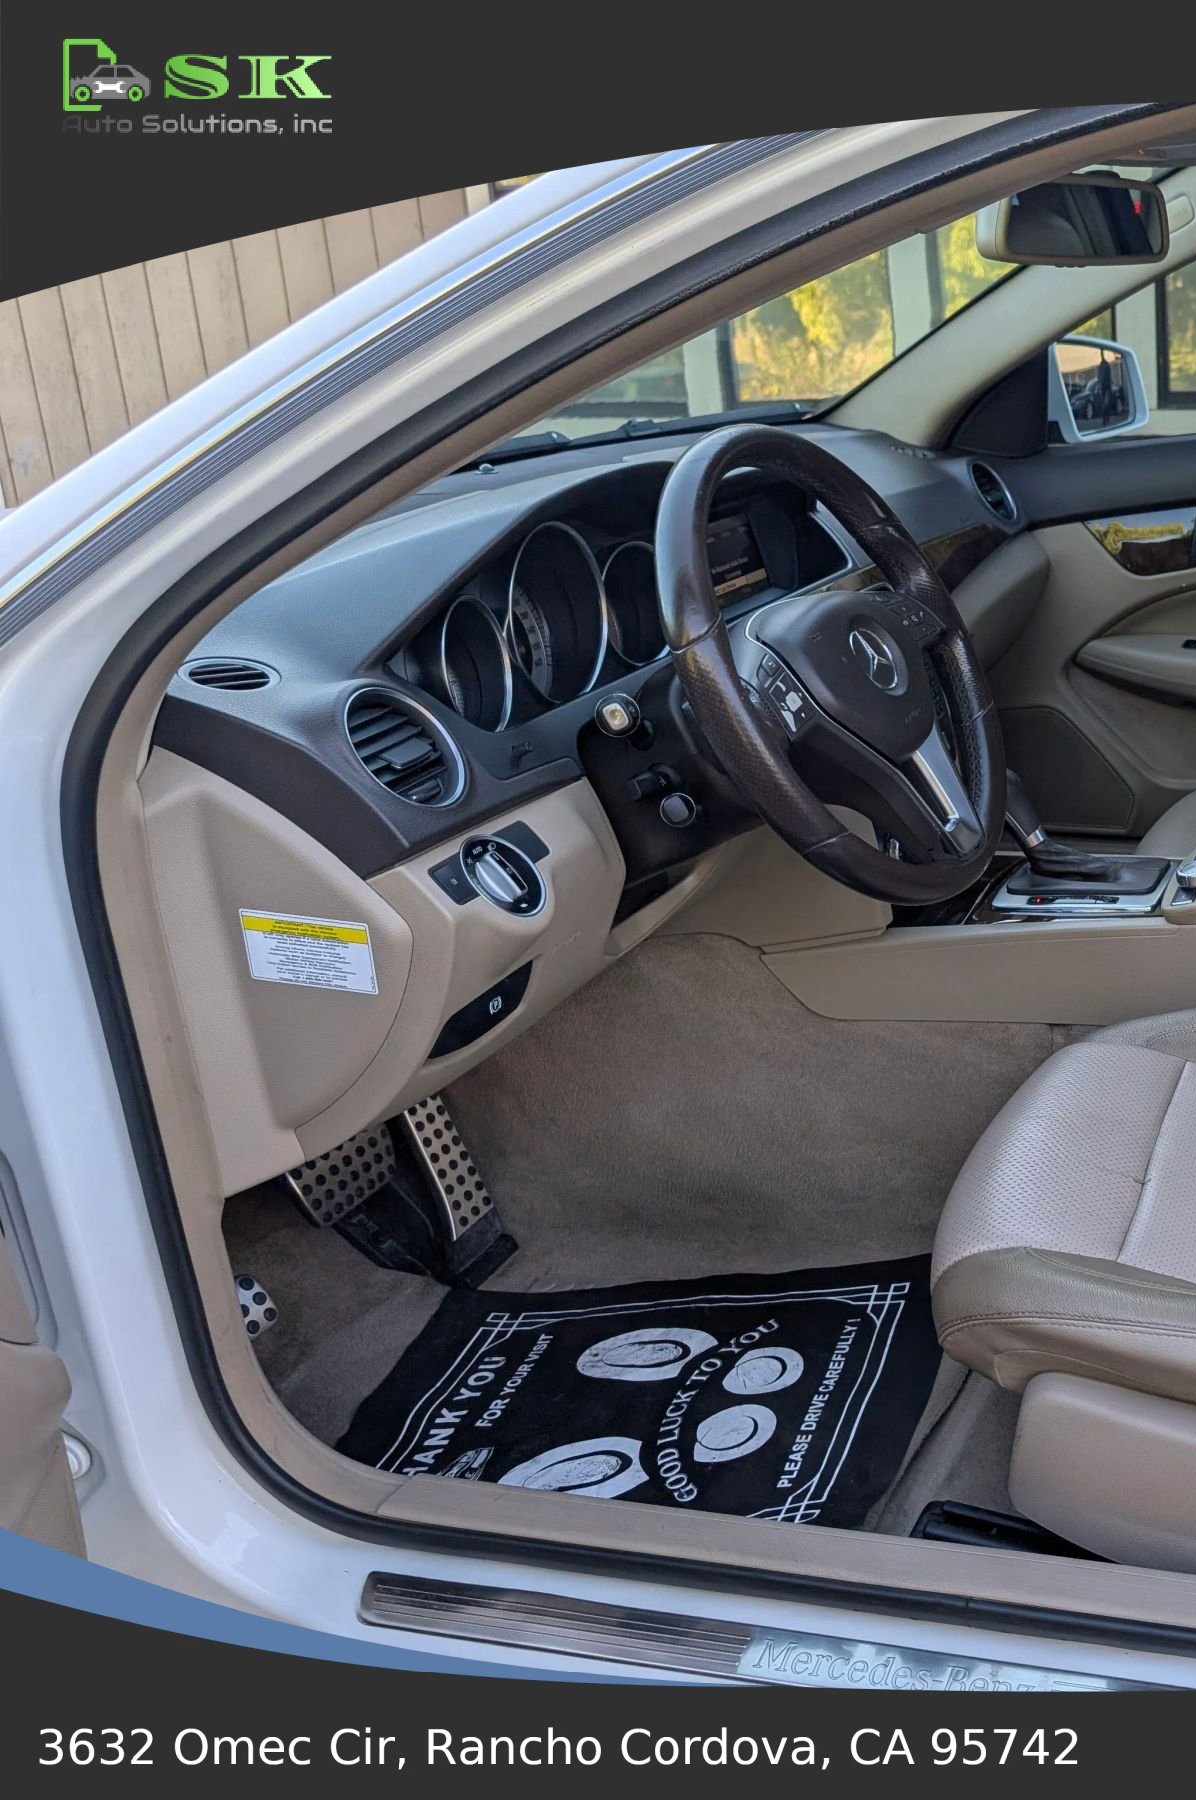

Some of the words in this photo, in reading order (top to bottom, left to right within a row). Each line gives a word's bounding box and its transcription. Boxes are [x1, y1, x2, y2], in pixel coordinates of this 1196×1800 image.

[717, 1317, 781, 1355] YOU
[474, 1398, 509, 1428] FOR
[499, 1361, 534, 1400] YOUR
[526, 1333, 554, 1368] VISIT
[689, 1356, 724, 1384] TO
[402, 1406, 468, 1478] HANK
[453, 1355, 507, 1401] YOU
[656, 1385, 699, 1446] LUCK
[776, 1428, 813, 1489] PLEASE
[801, 1392, 830, 1432] DRIVE
[656, 1447, 699, 1503] GOOD
